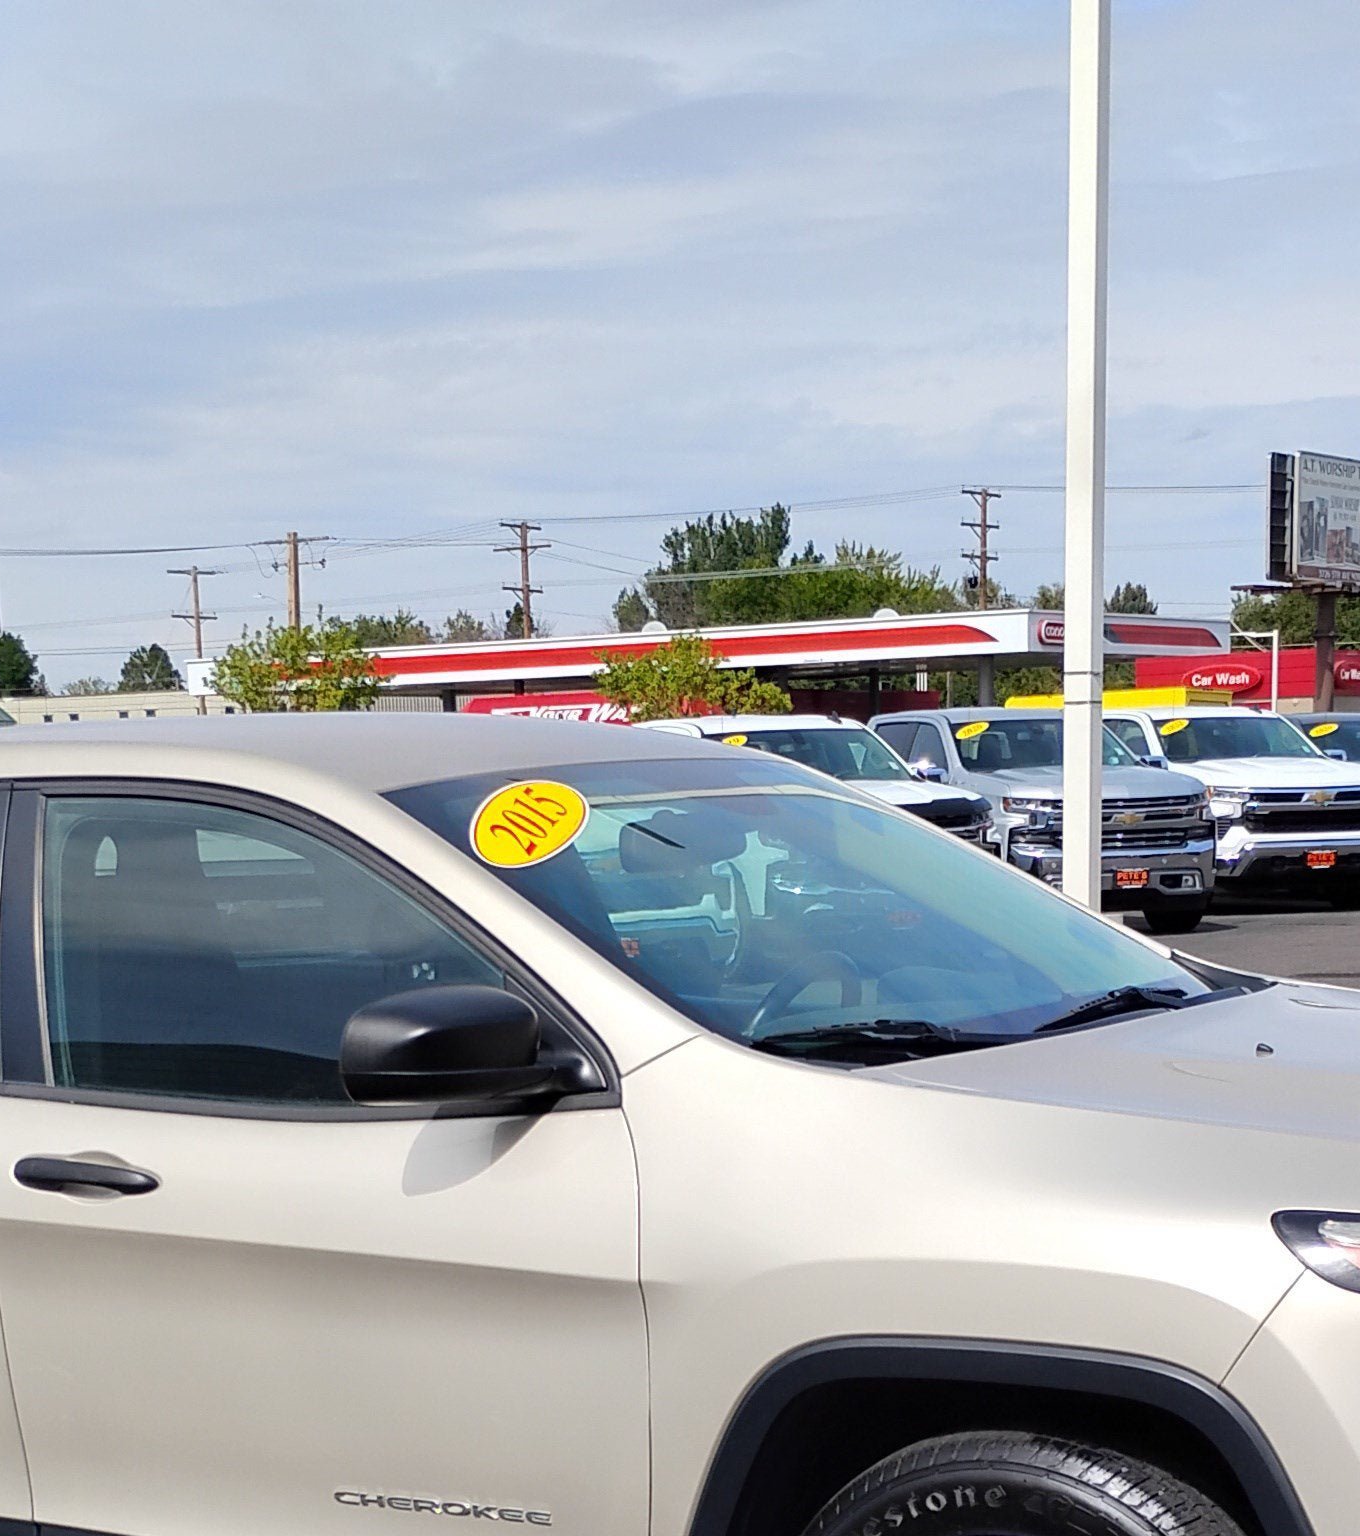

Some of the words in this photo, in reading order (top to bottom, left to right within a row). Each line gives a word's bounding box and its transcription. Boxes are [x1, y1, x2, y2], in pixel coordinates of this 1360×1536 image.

[1319, 461, 1356, 479] WORSHIP
[1192, 673, 1213, 687] Car
[1215, 672, 1250, 686] Wash
[490, 787, 568, 857] 2015
[334, 1491, 553, 1527] CHEROKEE
